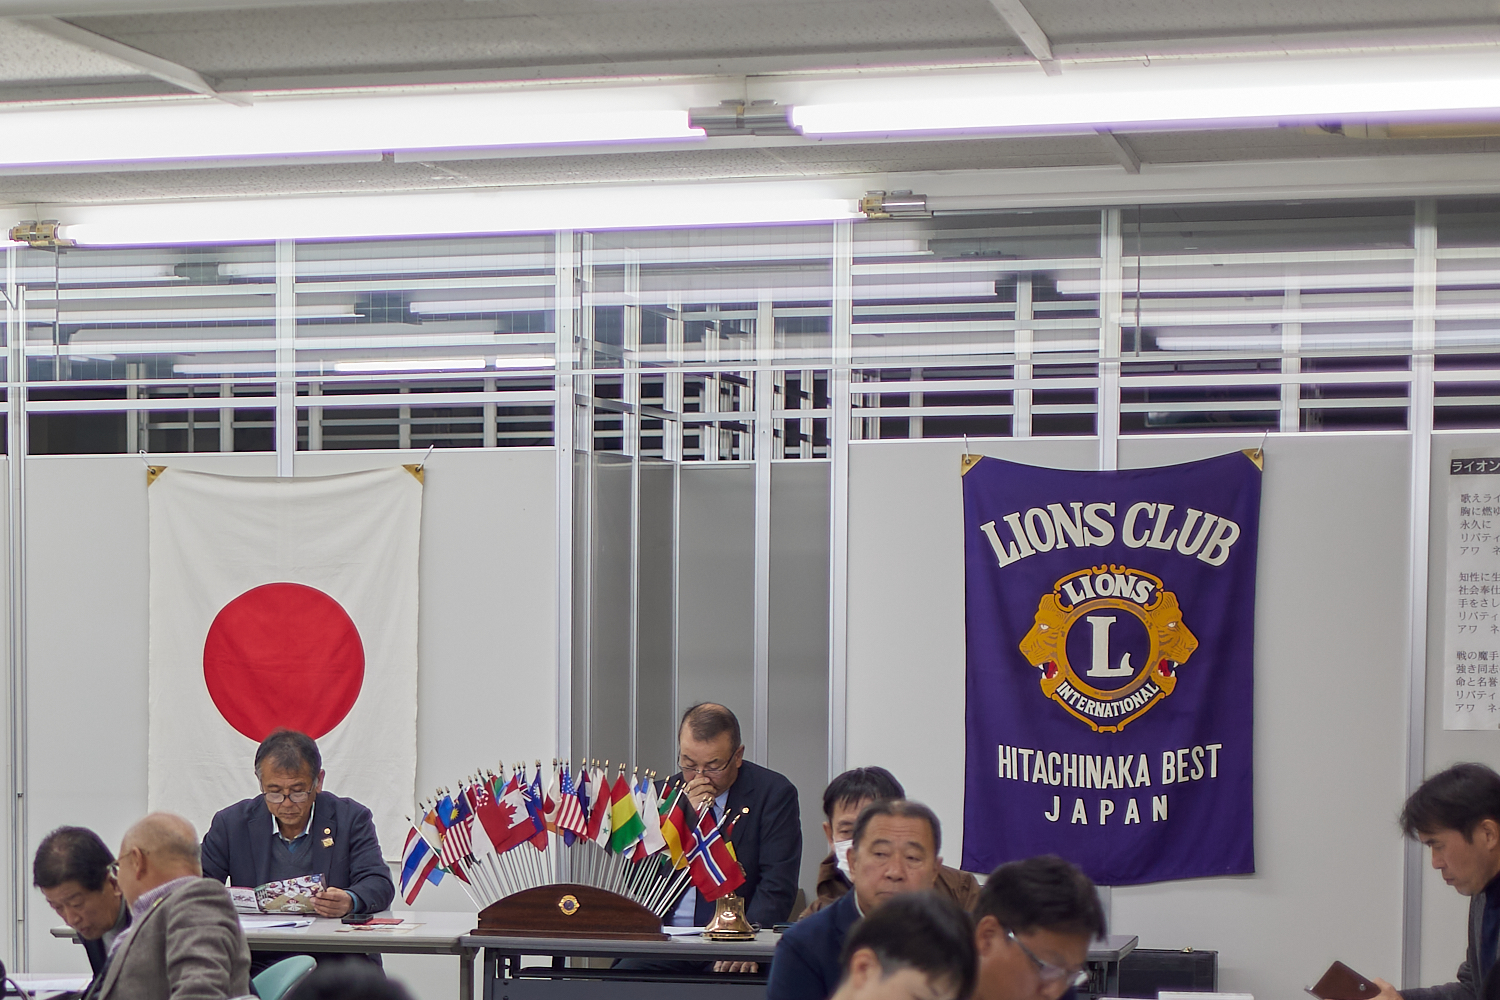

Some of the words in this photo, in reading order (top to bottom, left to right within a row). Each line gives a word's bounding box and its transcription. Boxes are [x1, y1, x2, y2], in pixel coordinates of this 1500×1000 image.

[1452, 460, 1500, 473] ライオン
[1460, 519, 1492, 530] 永久に
[980, 502, 1116, 568] LIONS
[1122, 501, 1241, 567] CLUB
[1460, 546, 1480, 556] アワ
[1062, 573, 1155, 605] LIONS
[1459, 585, 1500, 595] 社会奉仕
[1458, 598, 1500, 608] 手をさし
[1458, 624, 1477, 634] アワ
[1086, 616, 1134, 677] L
[1456, 650, 1499, 661] 戦の魔手
[1456, 664, 1500, 674] 強き同志
[1455, 677, 1498, 687] 命と名誉
[1056, 682, 1160, 718] INTERNATIONAL
[1456, 690, 1496, 700] リバティ
[1455, 703, 1475, 713] アワ
[1488, 703, 1500, 713] ネ
[998, 745, 1151, 789] HITACHINAKA
[1161, 743, 1222, 785] BEST
[1044, 795, 1168, 825] JAPAN
